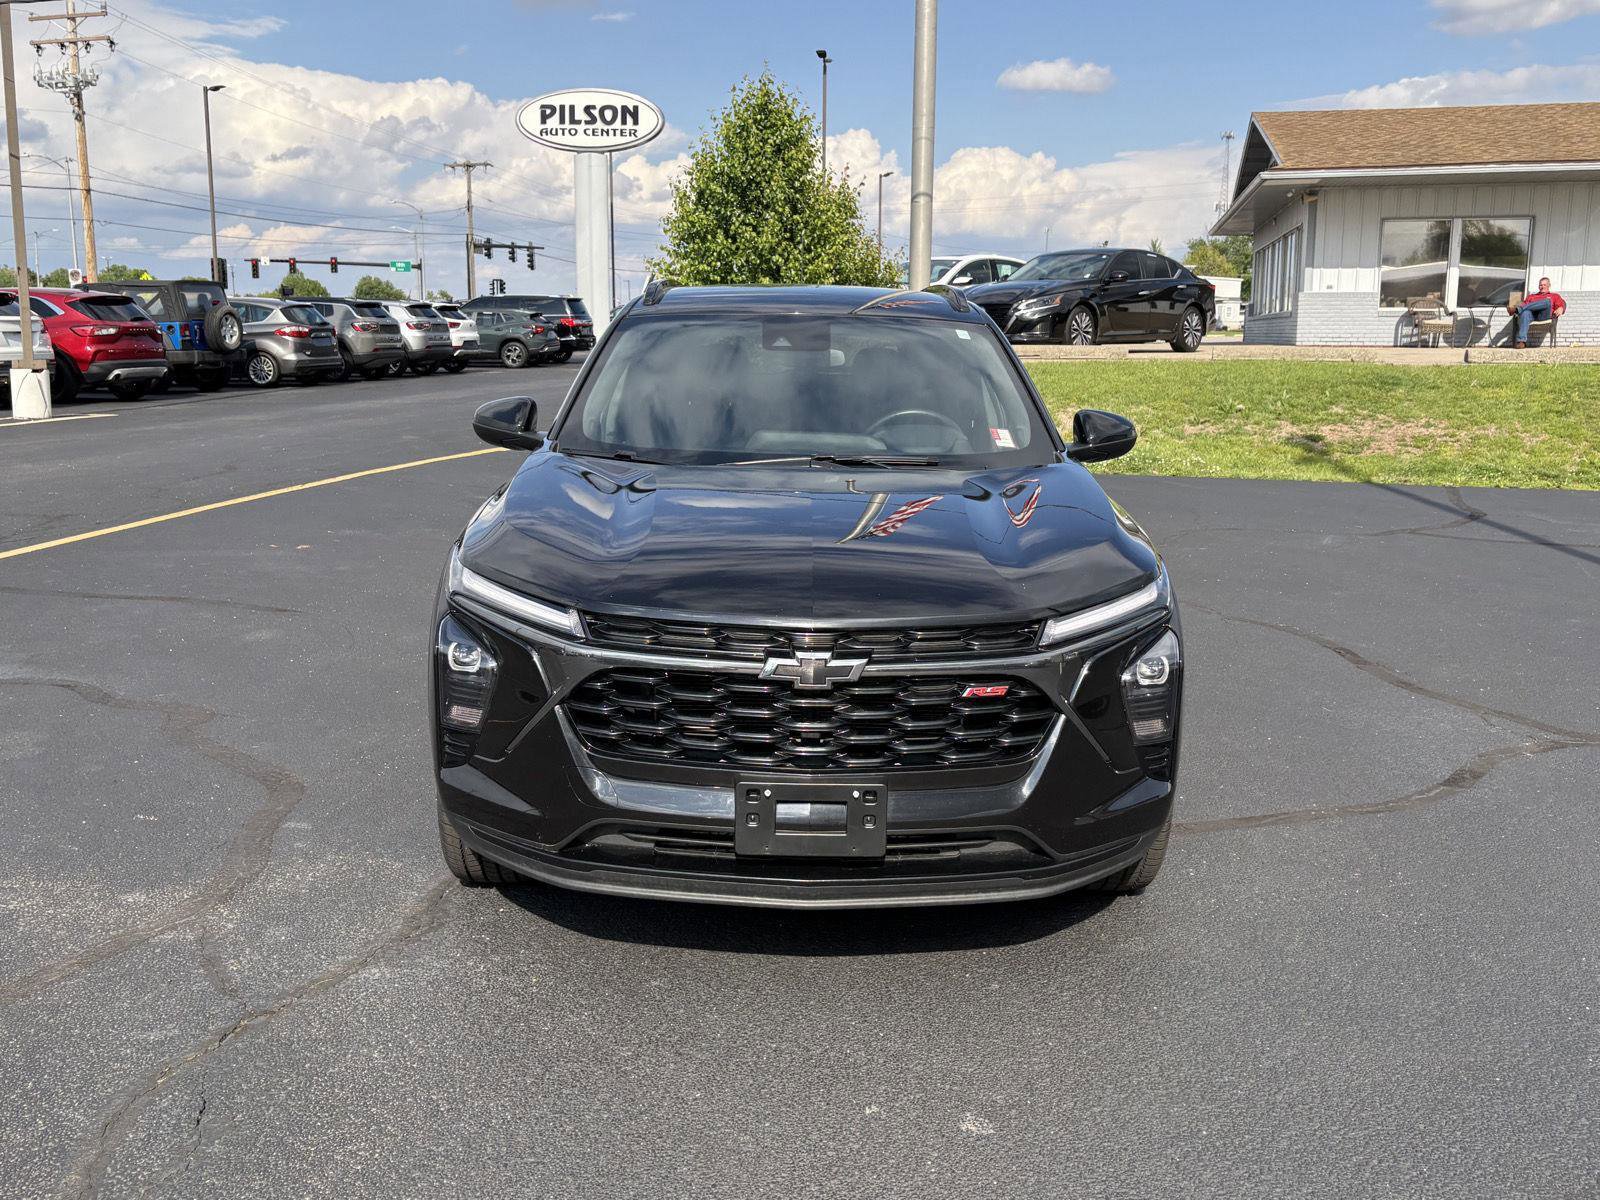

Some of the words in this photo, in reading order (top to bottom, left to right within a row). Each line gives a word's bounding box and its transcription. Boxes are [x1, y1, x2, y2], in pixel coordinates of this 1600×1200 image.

[539, 104, 640, 126] PILSON
[539, 127, 578, 137] AUTO
[583, 127, 639, 138] CENTER
[962, 684, 1010, 698] RS
